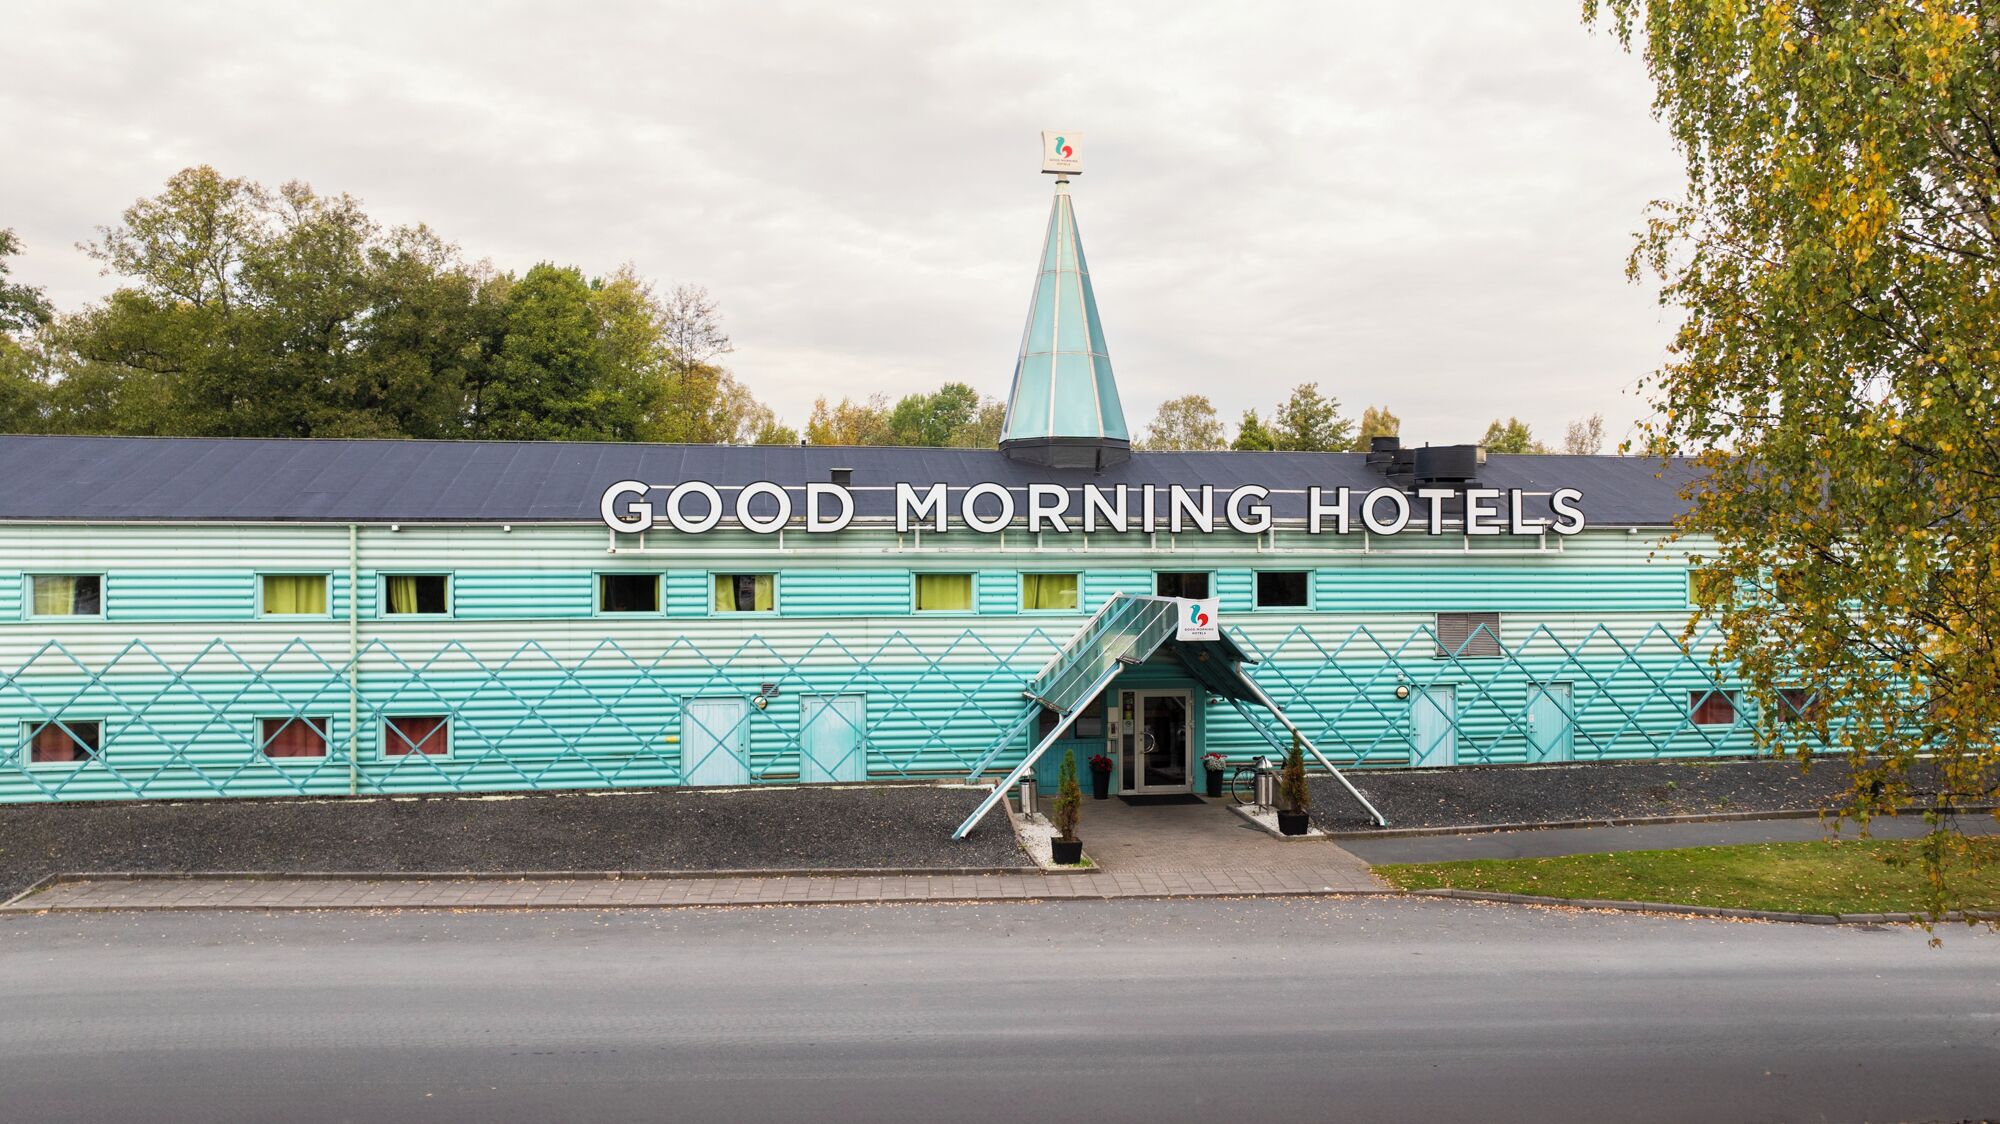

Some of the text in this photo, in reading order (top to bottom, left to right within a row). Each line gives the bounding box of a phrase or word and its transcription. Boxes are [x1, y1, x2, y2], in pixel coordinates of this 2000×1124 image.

[600, 480, 1586, 535] GOOD MORNING HOTELS
